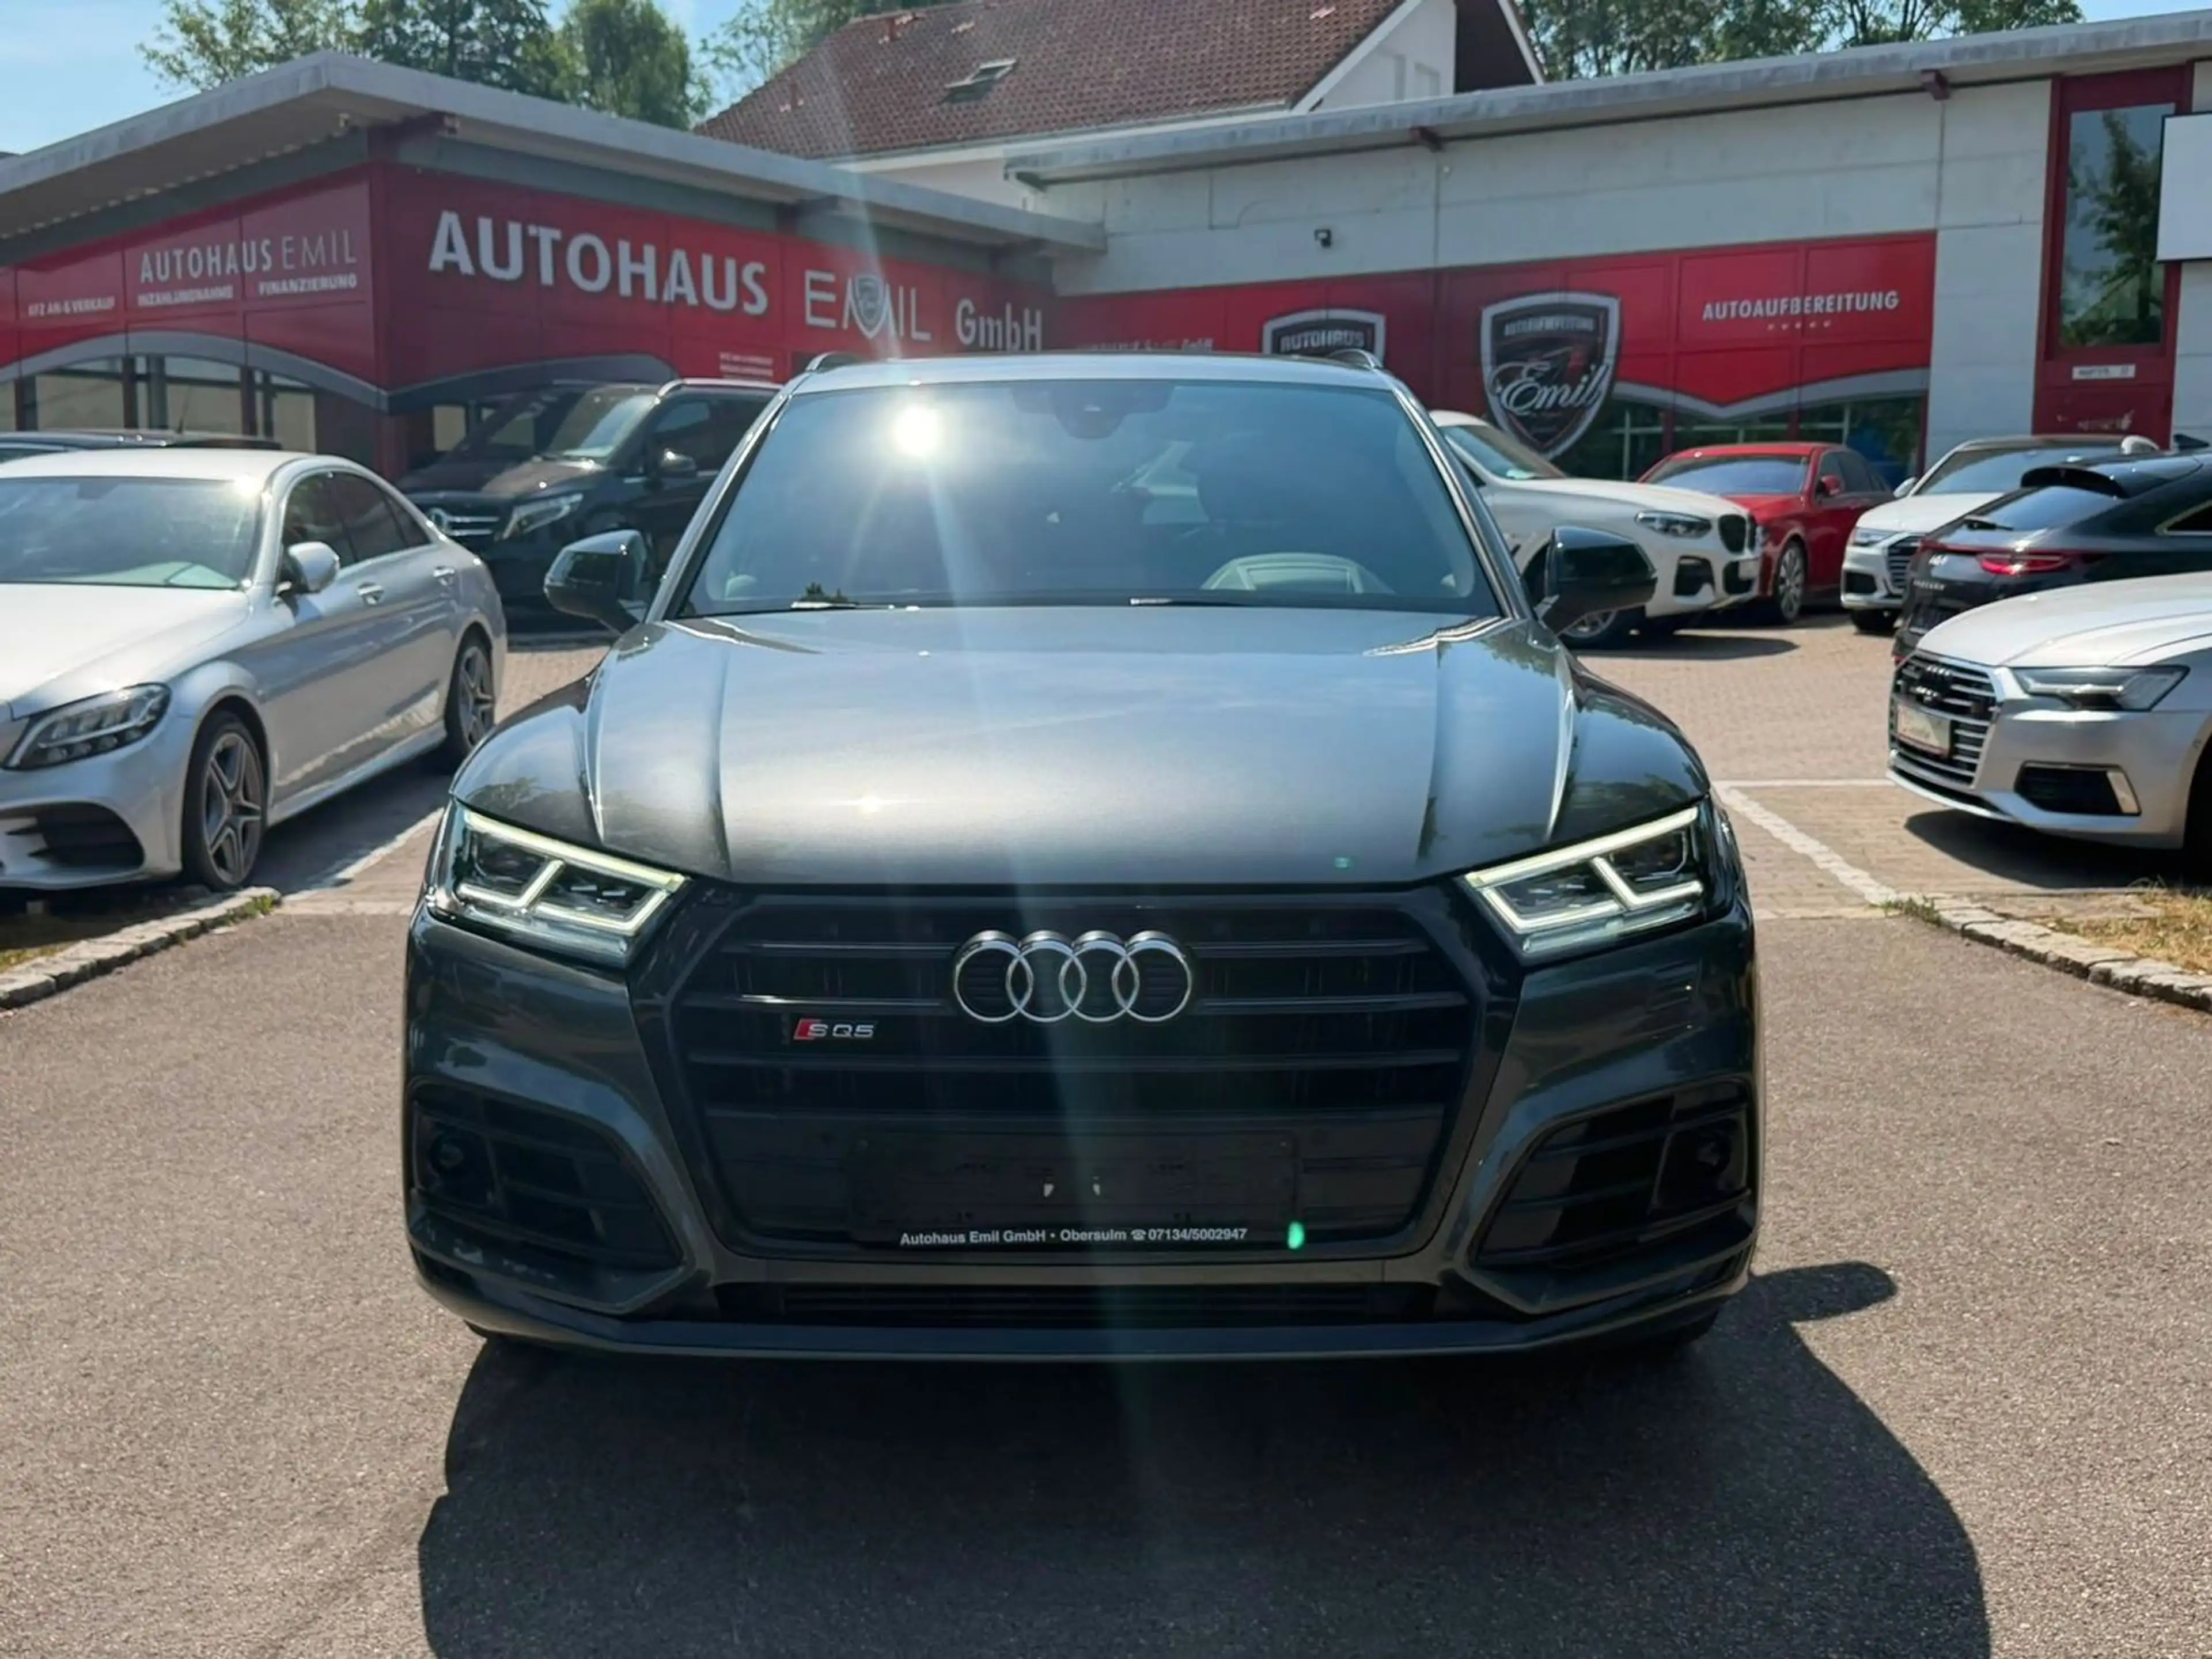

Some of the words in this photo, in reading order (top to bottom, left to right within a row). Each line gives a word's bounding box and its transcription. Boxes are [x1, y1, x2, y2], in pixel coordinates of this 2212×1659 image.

[141, 239, 273, 283] AUTOHAUS
[282, 229, 357, 270] EMIL
[259, 272, 357, 296] FINANZIERUNG
[429, 210, 769, 316] AUTOHAUS
[956, 298, 1043, 352] GmbH
[1703, 291, 1899, 320] AUTOAUFBEREITUNG
[1489, 362, 1611, 415] Emil
[807, 1022, 874, 1038] SQ5
[900, 1232, 965, 1245] Autohaus
[970, 1231, 999, 1243] Emil
[1003, 1230, 1046, 1243] GmbH
[1060, 1228, 1127, 1241] Obersulm
[1148, 1228, 1248, 1241] 07134/5002947
